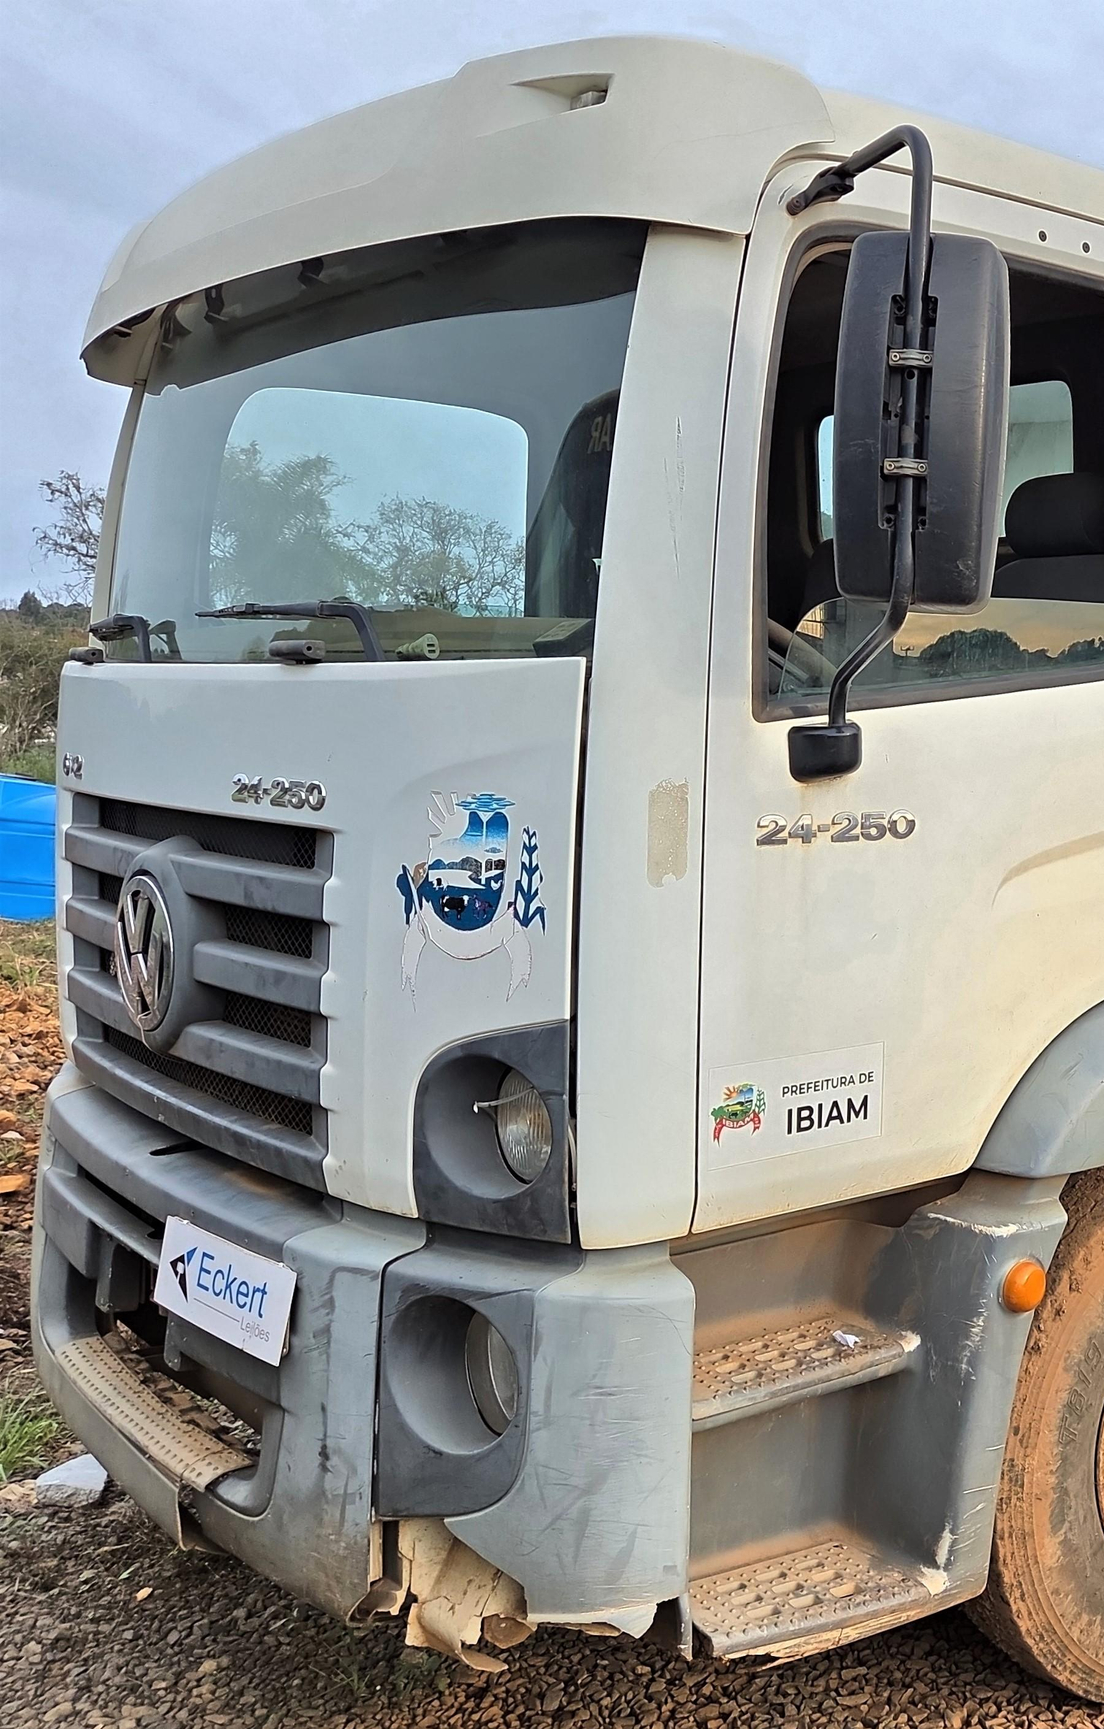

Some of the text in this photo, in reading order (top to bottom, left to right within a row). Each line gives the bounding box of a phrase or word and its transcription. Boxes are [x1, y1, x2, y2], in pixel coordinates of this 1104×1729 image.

[231, 773, 326, 812] 24-250
[756, 810, 917, 846] 24-250
[781, 1071, 875, 1098] PREFEITURA DE
[786, 1094, 869, 1135] IBIAM
[196, 1251, 268, 1319] Eckert
